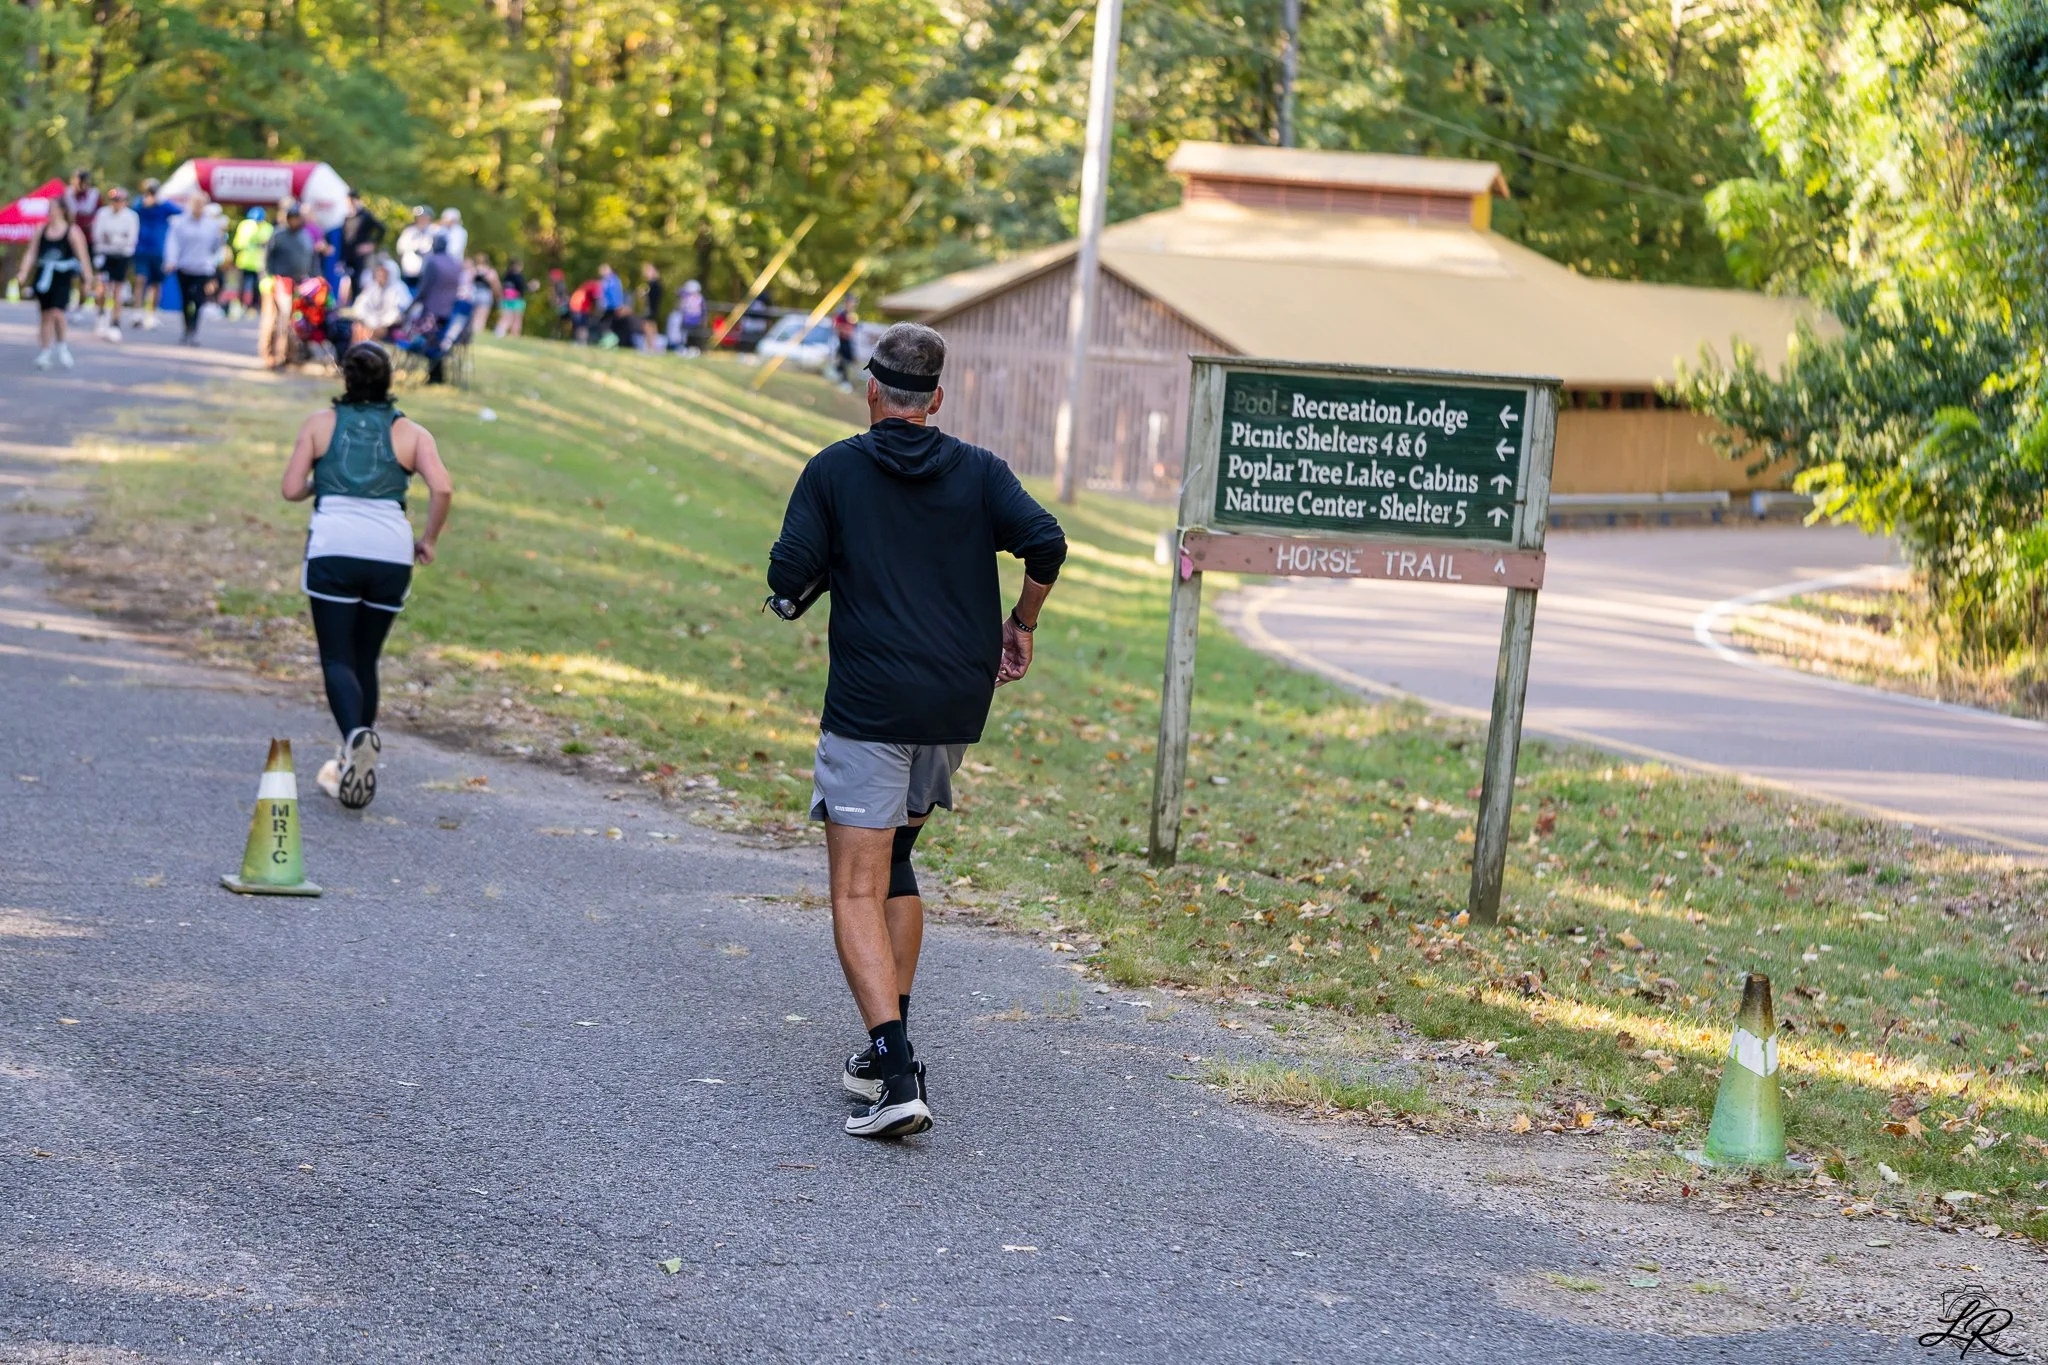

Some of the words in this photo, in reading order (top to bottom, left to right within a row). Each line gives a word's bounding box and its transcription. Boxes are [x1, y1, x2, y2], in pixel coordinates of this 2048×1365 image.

[1291, 393, 1400, 425] Recreation
[1405, 400, 1469, 436] Lodge
[1230, 422, 1294, 450] Picnic
[1295, 423, 1378, 455] Shelters
[1380, 431, 1394, 457] 4
[1396, 432, 1412, 457] &
[1414, 431, 1427, 459] 6
[1227, 453, 1295, 487] Poplar
[1297, 458, 1343, 485] Tree
[1345, 459, 1396, 488] Lake
[1408, 463, 1479, 493] Cabins
[1224, 486, 1294, 514] Nature
[1296, 490, 1367, 518] Center
[1379, 492, 1453, 524] Shelter
[1454, 500, 1468, 527] 5
[1276, 544, 1363, 575] HORSE
[1381, 550, 1462, 580] TRAIL
[271, 804, 290, 864] MRTC
